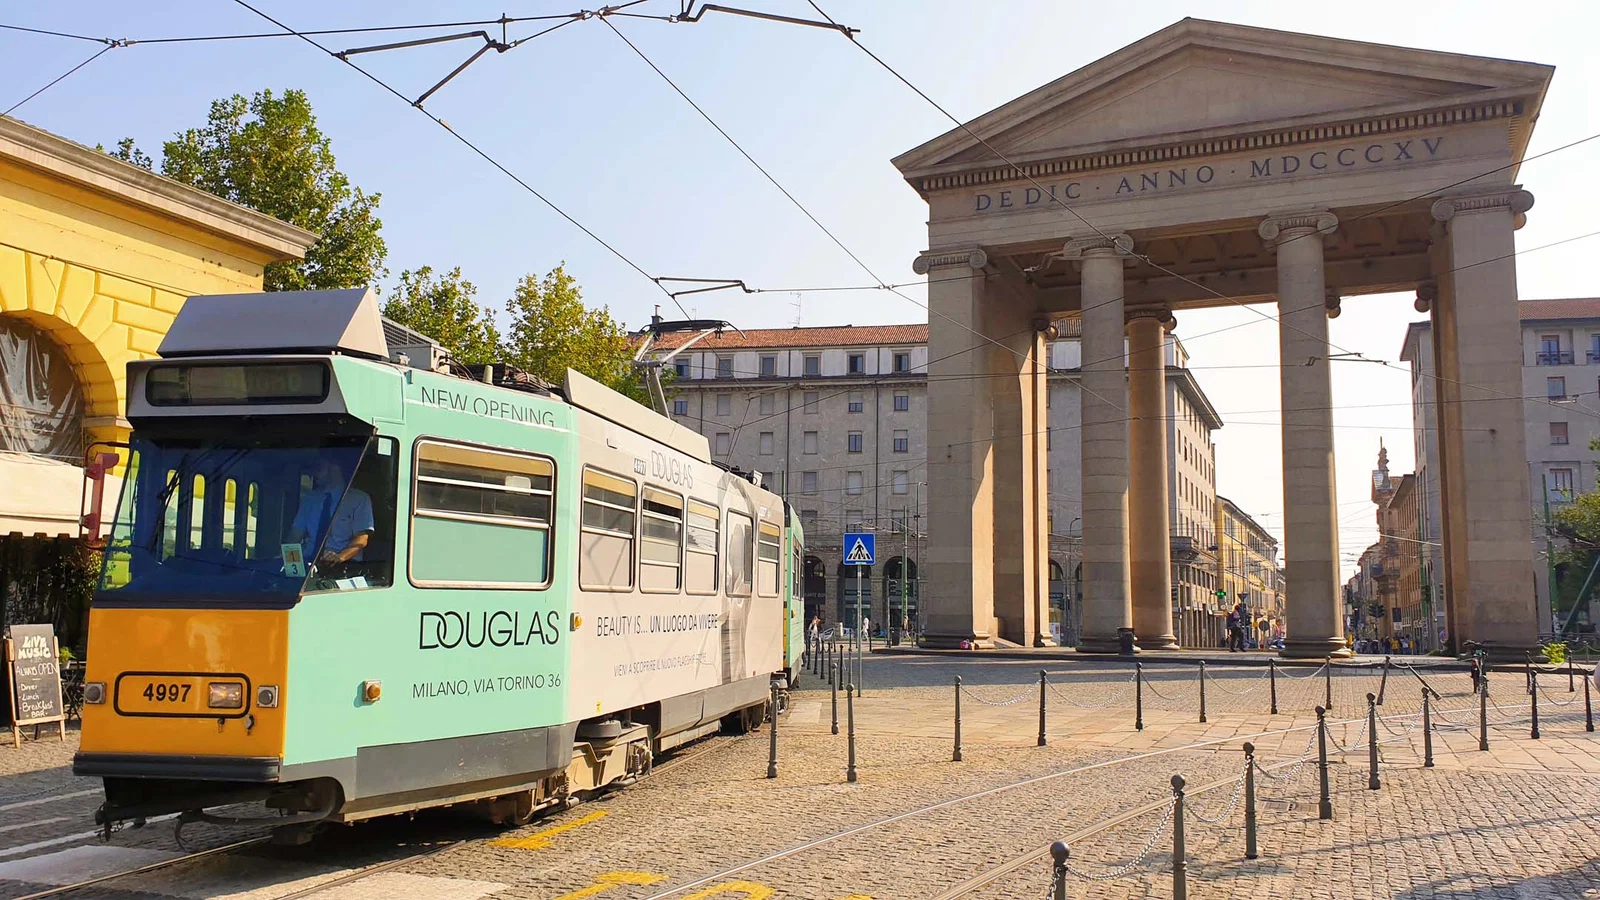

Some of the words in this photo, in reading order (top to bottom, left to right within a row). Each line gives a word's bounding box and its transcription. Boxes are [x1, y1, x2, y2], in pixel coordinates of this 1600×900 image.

[976, 182, 1082, 211] DEDIC
[1115, 165, 1214, 195] ANNO
[1250, 136, 1444, 178] MDCCCXV
[420, 386, 468, 411] NEW
[473, 397, 555, 428] OPENING
[651, 449, 694, 490] DOUGLAS
[291, 564, 298, 575] 3
[419, 610, 560, 650] DOUGLAS
[596, 615, 633, 637] BEAUTY
[650, 613, 661, 633] UN
[662, 614, 688, 633] LUOGO
[689, 613, 698, 631] DA
[699, 613, 718, 629] VIVERE
[22, 635, 47, 648] LIVE
[38, 662, 59, 675] OPEN
[22, 692, 40, 700] Lunch
[143, 683, 192, 702] 4997
[412, 679, 470, 699] MILANO,
[473, 678, 495, 693] VIA
[498, 674, 545, 692] TORINO
[548, 673, 561, 688] 36
[31, 710, 46, 719] BAR
